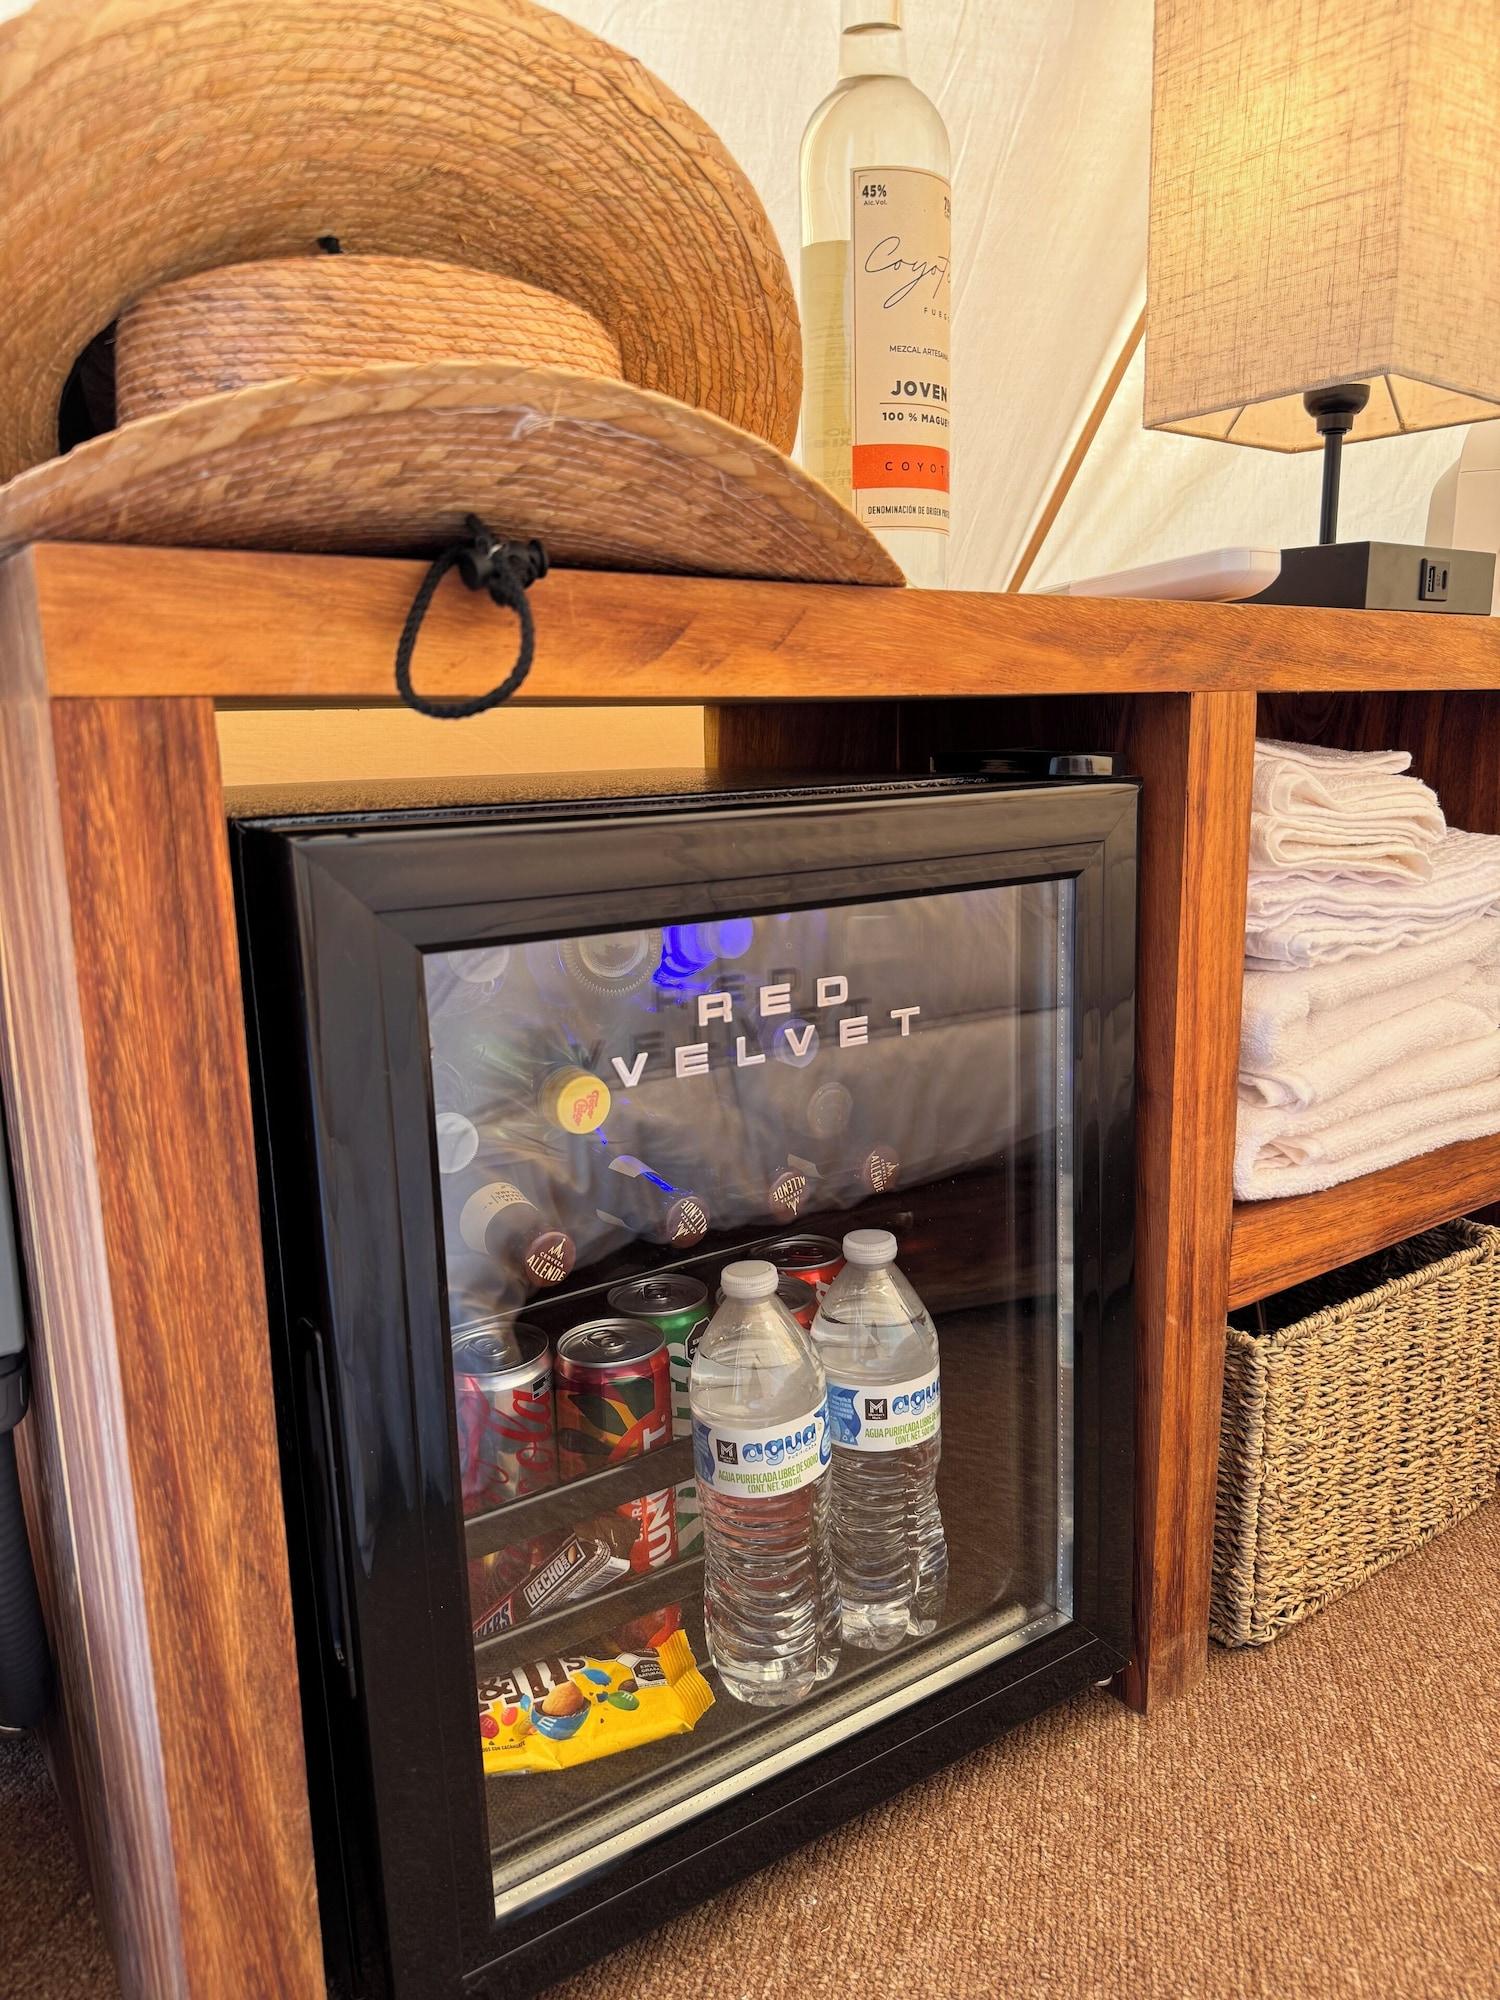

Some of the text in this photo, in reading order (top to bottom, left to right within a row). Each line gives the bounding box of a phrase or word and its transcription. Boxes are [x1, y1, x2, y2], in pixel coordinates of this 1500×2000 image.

[862, 184, 887, 198] 45%
[889, 345, 921, 354] MEZCAL
[890, 380, 947, 402] JOVEN
[882, 412, 950, 428] 100 % MAGUE
[885, 461, 949, 477] COYOT
[917, 506, 925, 515] DE
[698, 975, 849, 1027] RED
[611, 1006, 920, 1088] VELVET
[870, 1155, 885, 1193] ALLENDE
[773, 1176, 806, 1202] ALLENDE
[681, 1200, 708, 1234] ALLENDE
[526, 1254, 567, 1281] ALLENDE
[742, 1422, 817, 1466] agua
[864, 1427, 884, 1439] AGUA
[718, 1469, 736, 1484] AGUA
[735, 1471, 778, 1485] PURIFICADA
[777, 1464, 796, 1480] LIBRE
[795, 1461, 804, 1475] DE
[747, 1483, 766, 1494] CONT.
[766, 1480, 780, 1492] NET.
[780, 1477, 793, 1490] 500
[525, 1558, 566, 1603] HECHO
